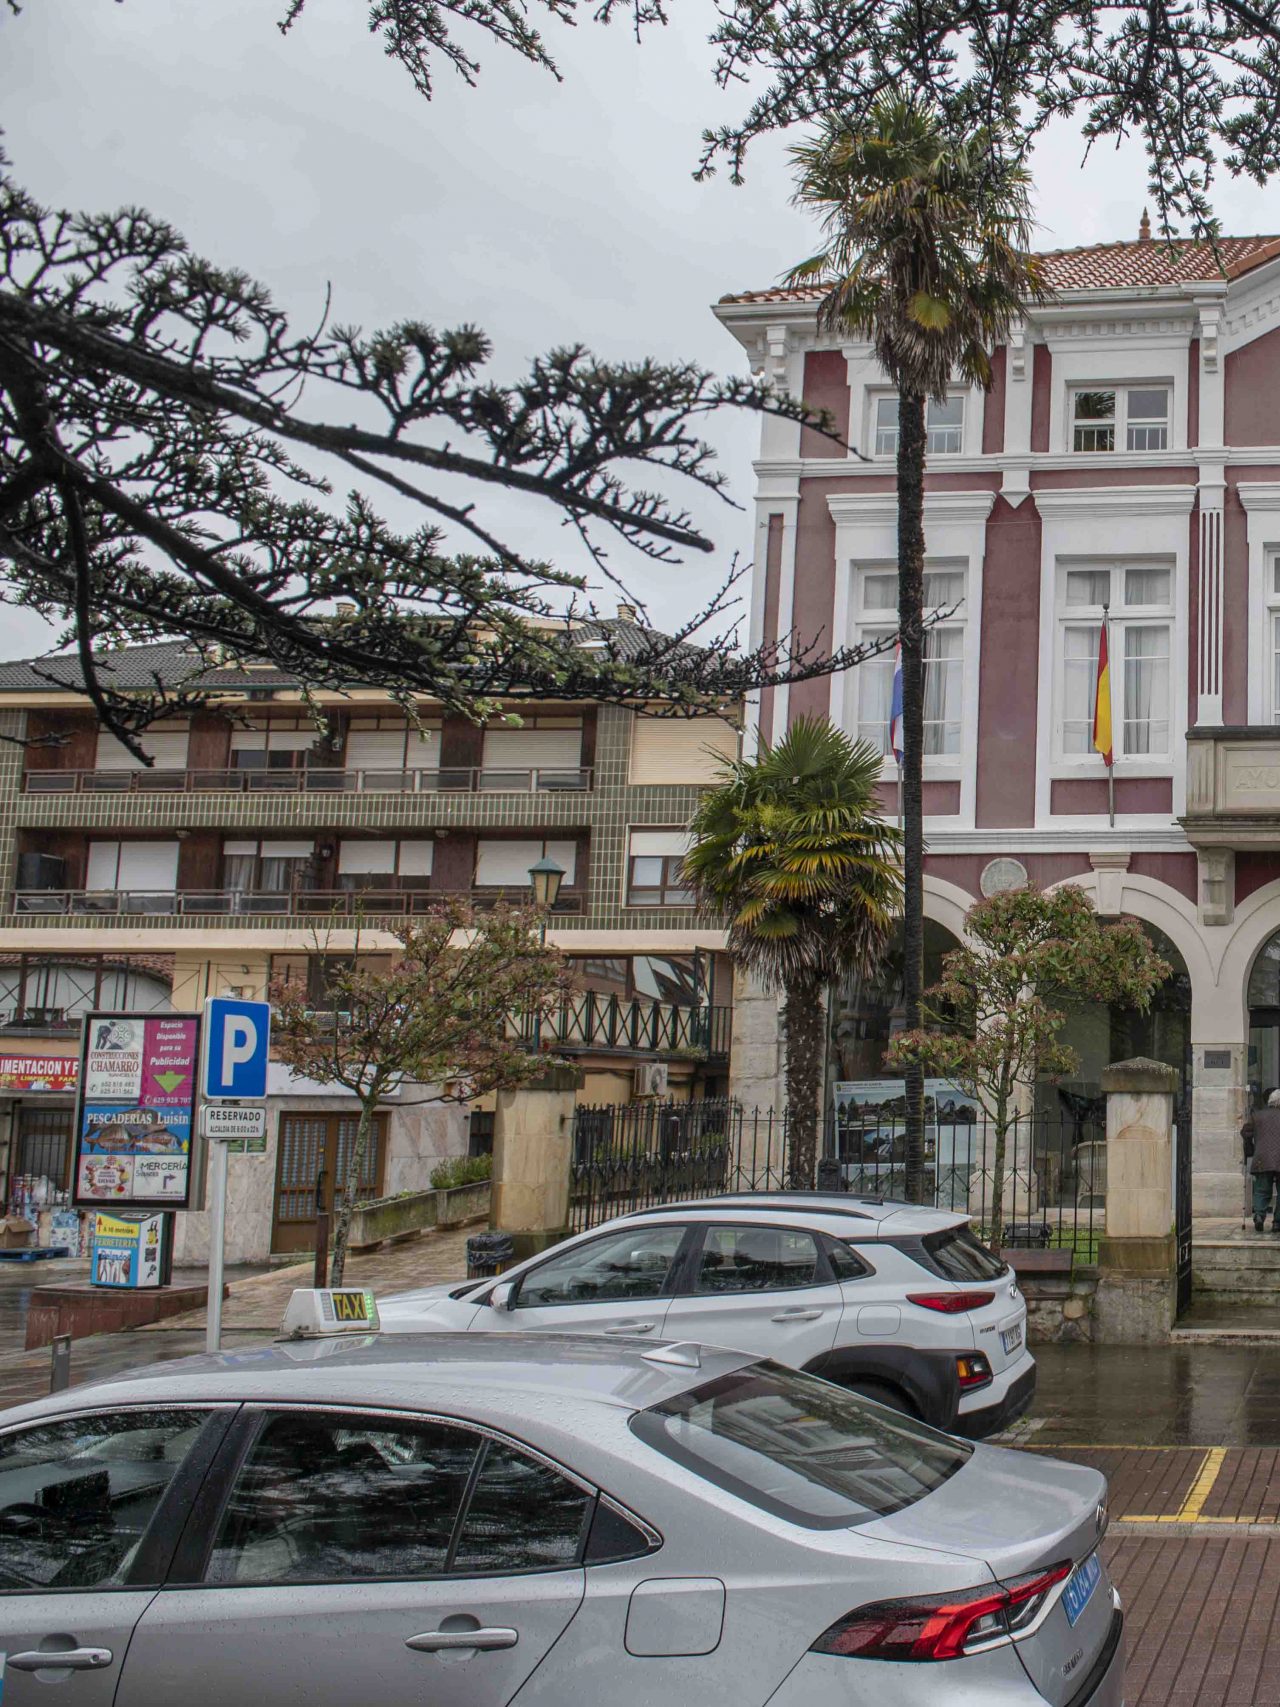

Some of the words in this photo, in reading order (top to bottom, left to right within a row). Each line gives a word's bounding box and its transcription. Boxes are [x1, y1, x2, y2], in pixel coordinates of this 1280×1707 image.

[90, 1052, 139, 1060] CONSTRUCCIONES
[221, 1013, 258, 1087] P
[90, 1061, 139, 1073] CHAMARRO
[150, 1056, 190, 1066] Publicidad
[64, 1061, 71, 1076] Y
[210, 1110, 261, 1121] RESERVADO
[332, 1294, 368, 1320] TAXI
